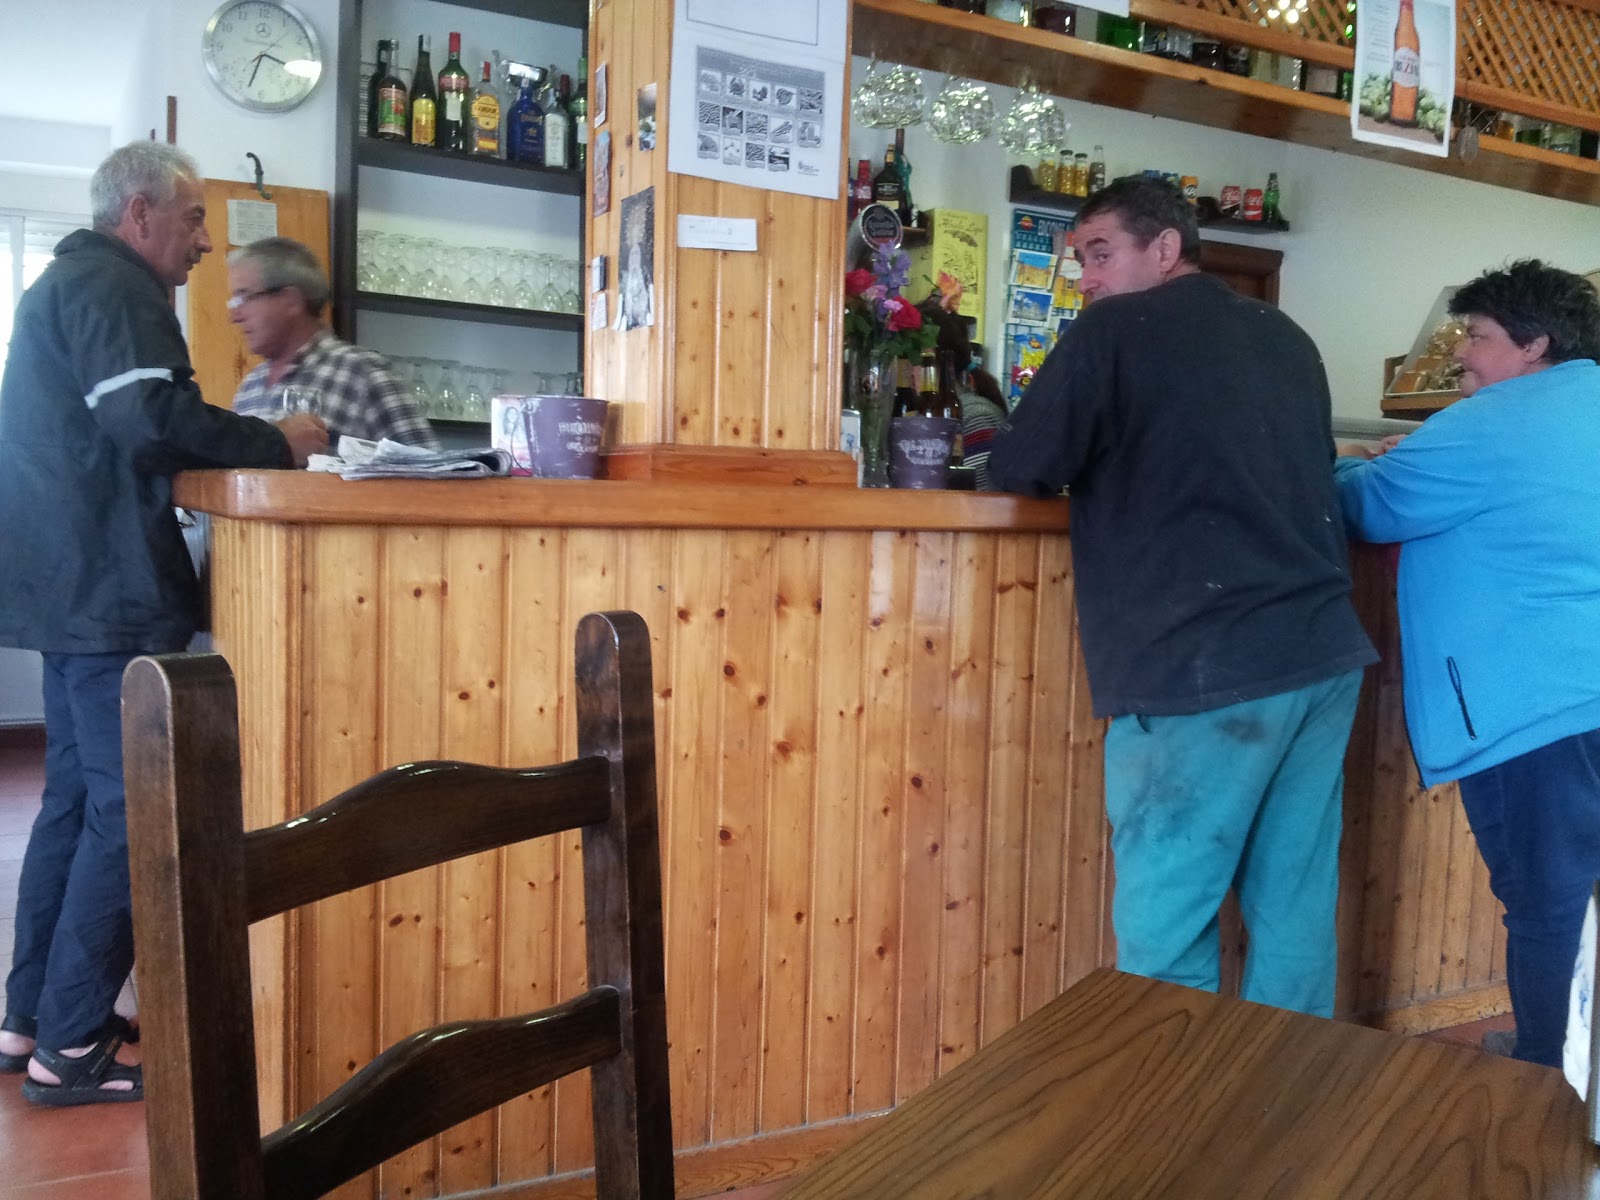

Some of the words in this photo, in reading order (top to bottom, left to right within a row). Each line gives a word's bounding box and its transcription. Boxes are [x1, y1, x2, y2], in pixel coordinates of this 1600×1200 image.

[238, 10, 248, 20] 11
[258, 8, 270, 18] 12
[222, 23, 233, 32] 10
[296, 35, 302, 45] 2
